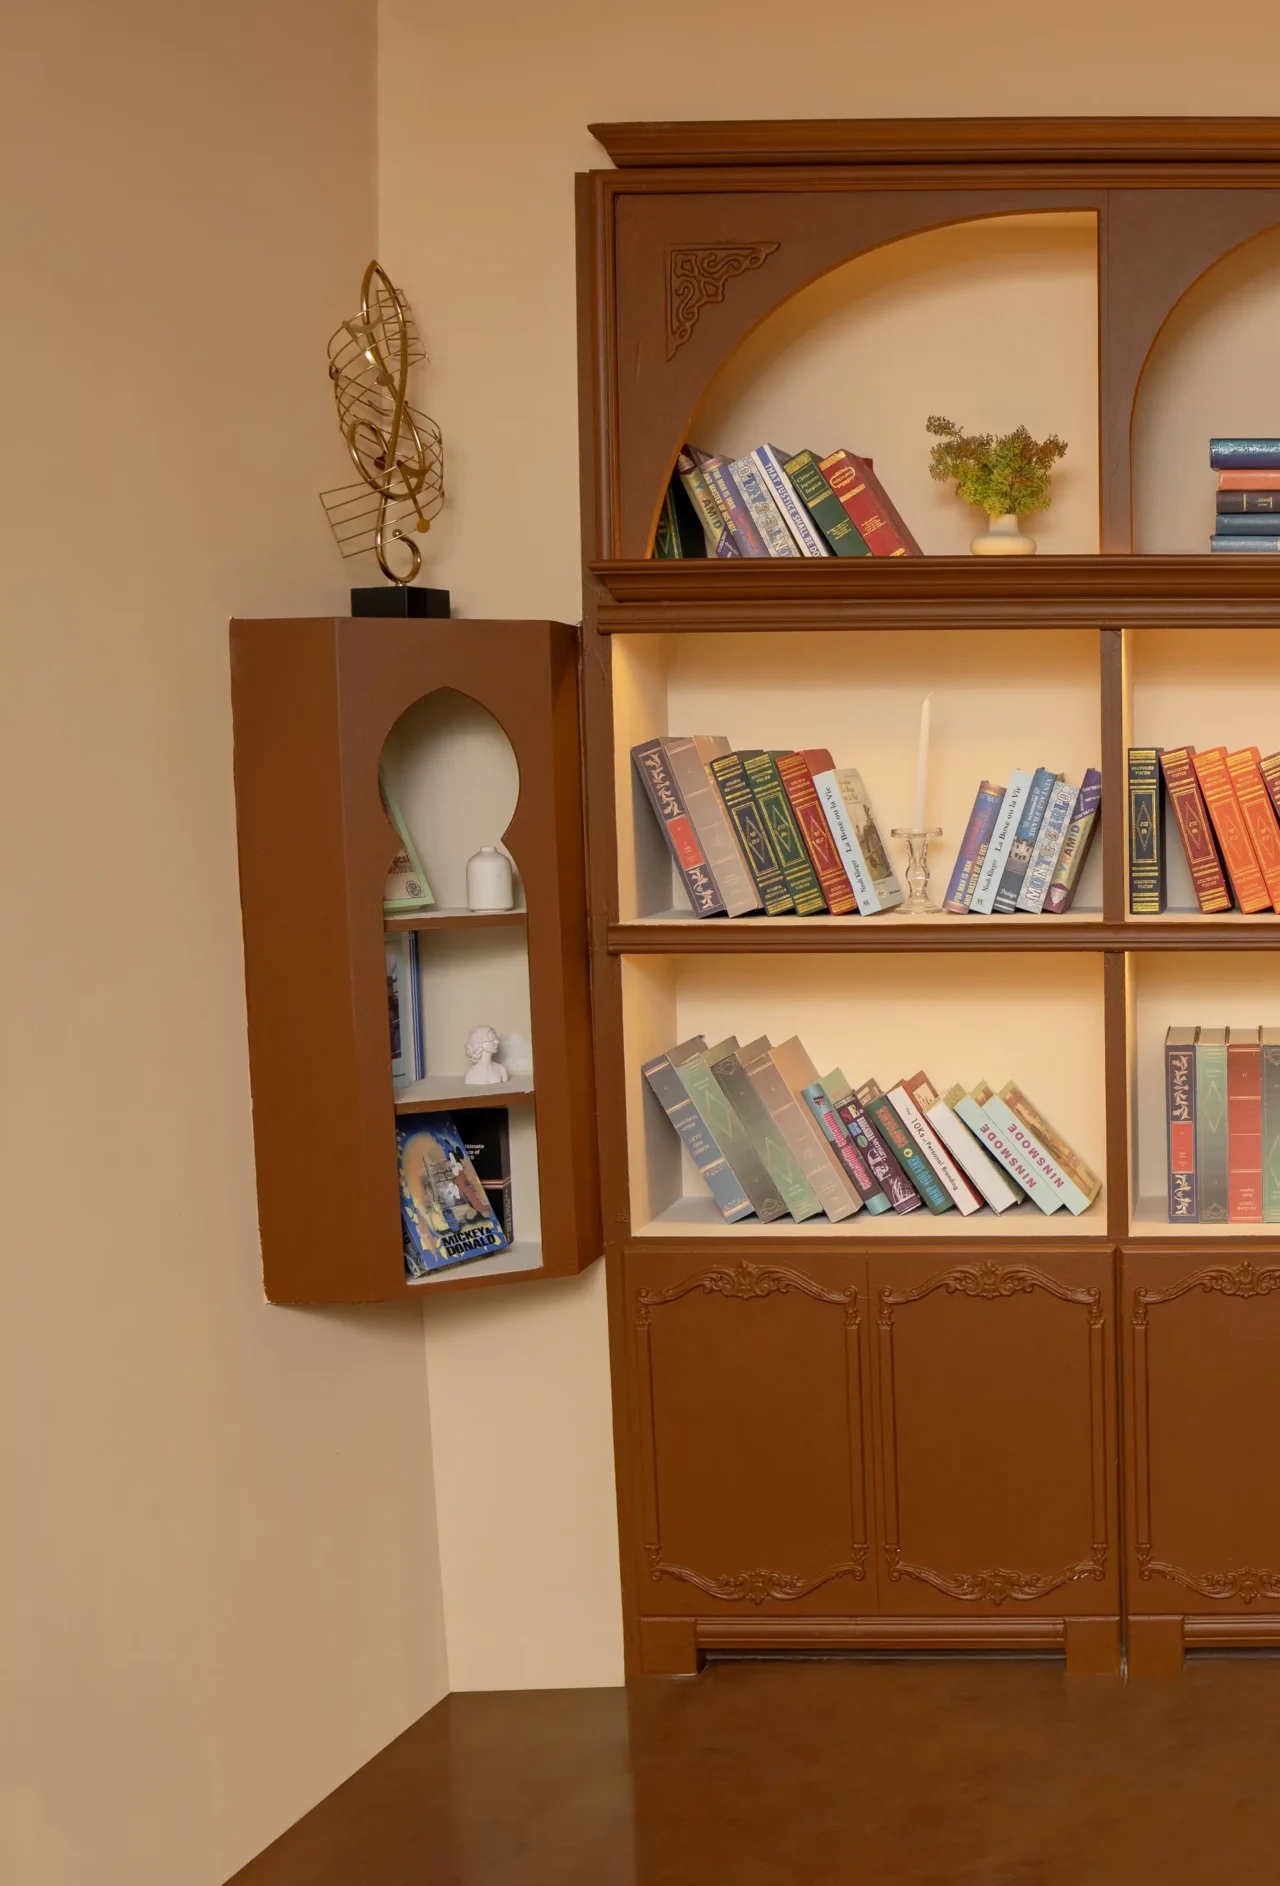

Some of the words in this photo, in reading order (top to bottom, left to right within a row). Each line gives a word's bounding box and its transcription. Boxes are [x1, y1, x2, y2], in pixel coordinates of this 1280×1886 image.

[703, 472, 713, 485] AND
[708, 483, 723, 505] MASTER
[765, 462, 783, 485] THAT
[776, 484, 797, 515] JUSTICE
[791, 511, 811, 541] SHALL
[804, 537, 816, 550] BE
[810, 547, 821, 558] DO
[825, 786, 833, 801] Vie
[1012, 785, 1022, 799] Vie
[837, 821, 848, 842] Boxe
[999, 823, 1009, 841] Boxe
[844, 840, 852, 854] La
[995, 841, 1004, 853] La
[1025, 844, 1055, 902] MONTE
[1044, 790, 1072, 842] CARLO
[956, 878, 966, 891] MAN
[966, 872, 979, 894] MASTER
[953, 889, 962, 902] FOR
[875, 1104, 909, 1149] CONFIDENCE
[907, 1155, 925, 1174] LIKE
[911, 1118, 925, 1138] 10Ks
[926, 1141, 944, 1166] Personal
[942, 1165, 959, 1191] Branding
[980, 1123, 1037, 1188] NINSMODE
[1007, 1123, 1065, 1188] NINSMODE
[918, 1170, 933, 1188] YOU
[926, 1183, 946, 1207] WHAT
[446, 1233, 496, 1257] DONALD
